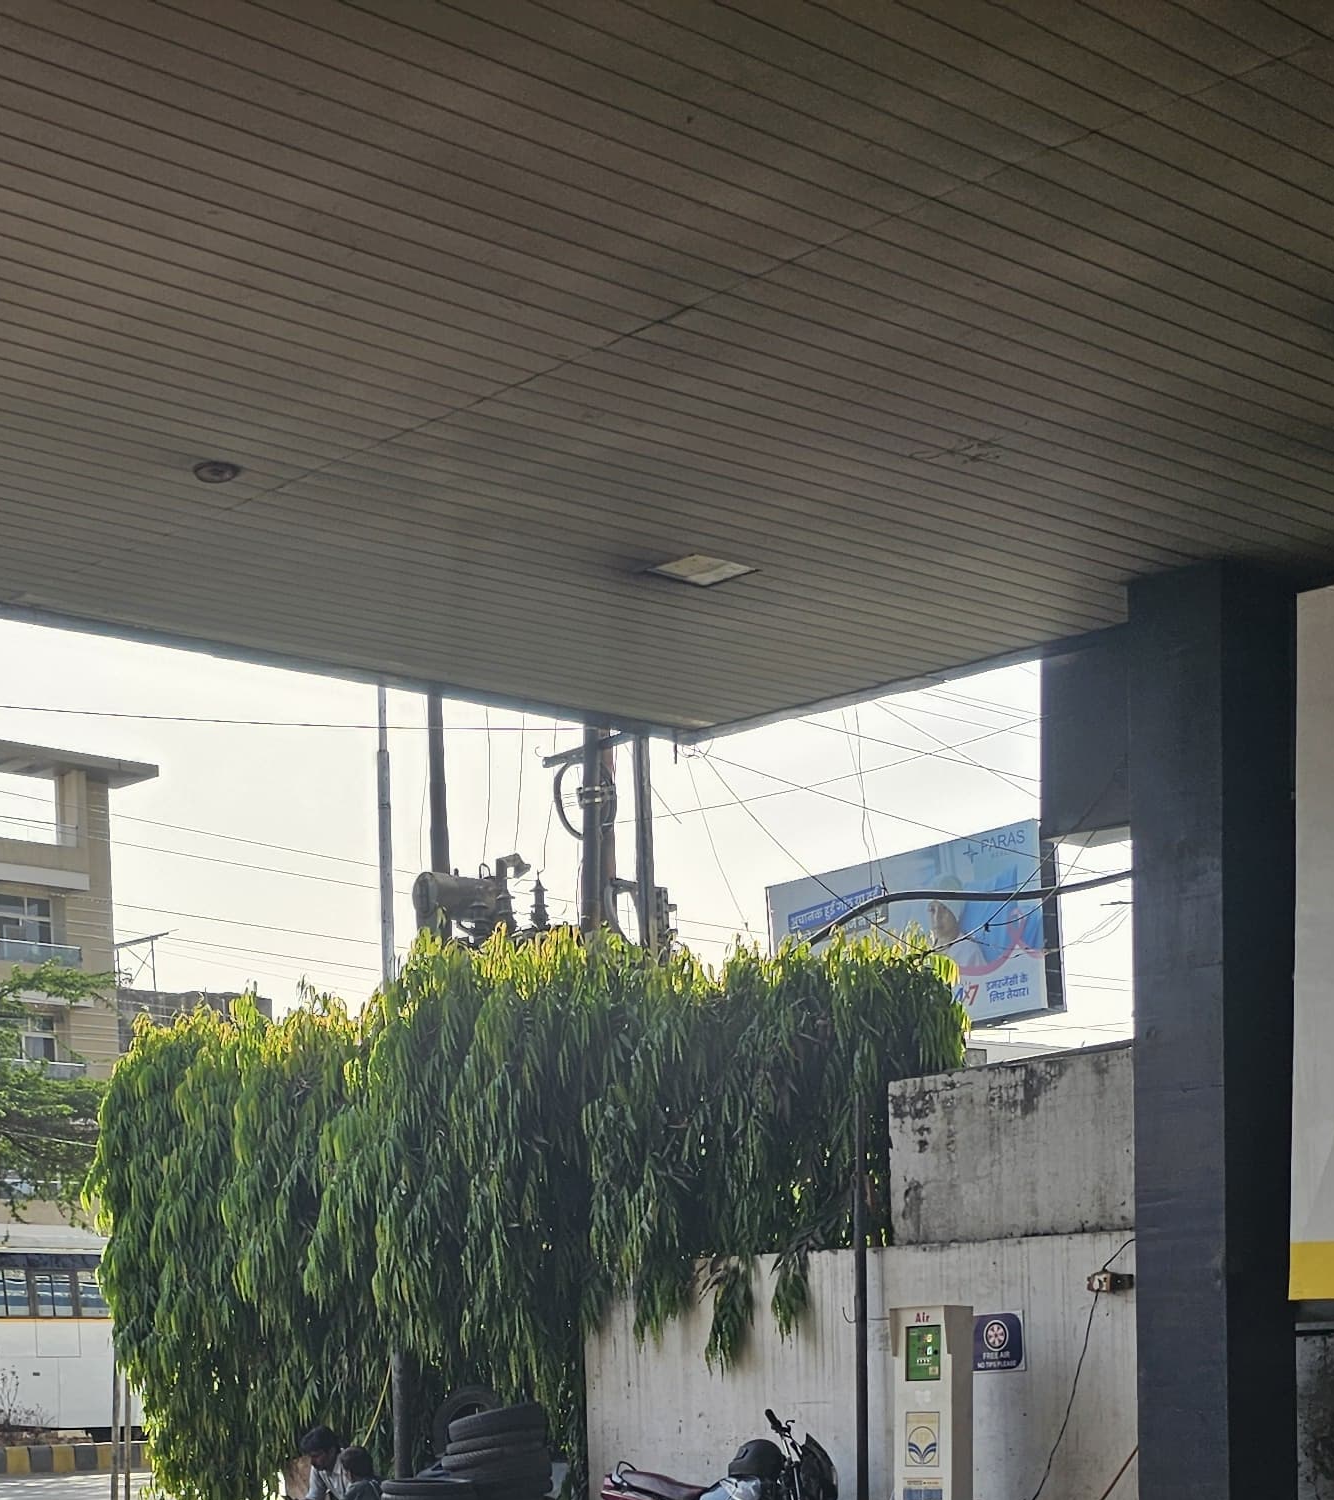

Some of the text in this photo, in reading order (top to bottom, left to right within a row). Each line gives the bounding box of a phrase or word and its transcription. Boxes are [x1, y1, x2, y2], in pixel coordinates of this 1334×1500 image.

[981, 830, 1025, 854] PARAS
[954, 984, 979, 1006] 4x7
[915, 1312, 930, 1323] Air
[999, 1351, 1010, 1359] AIR
